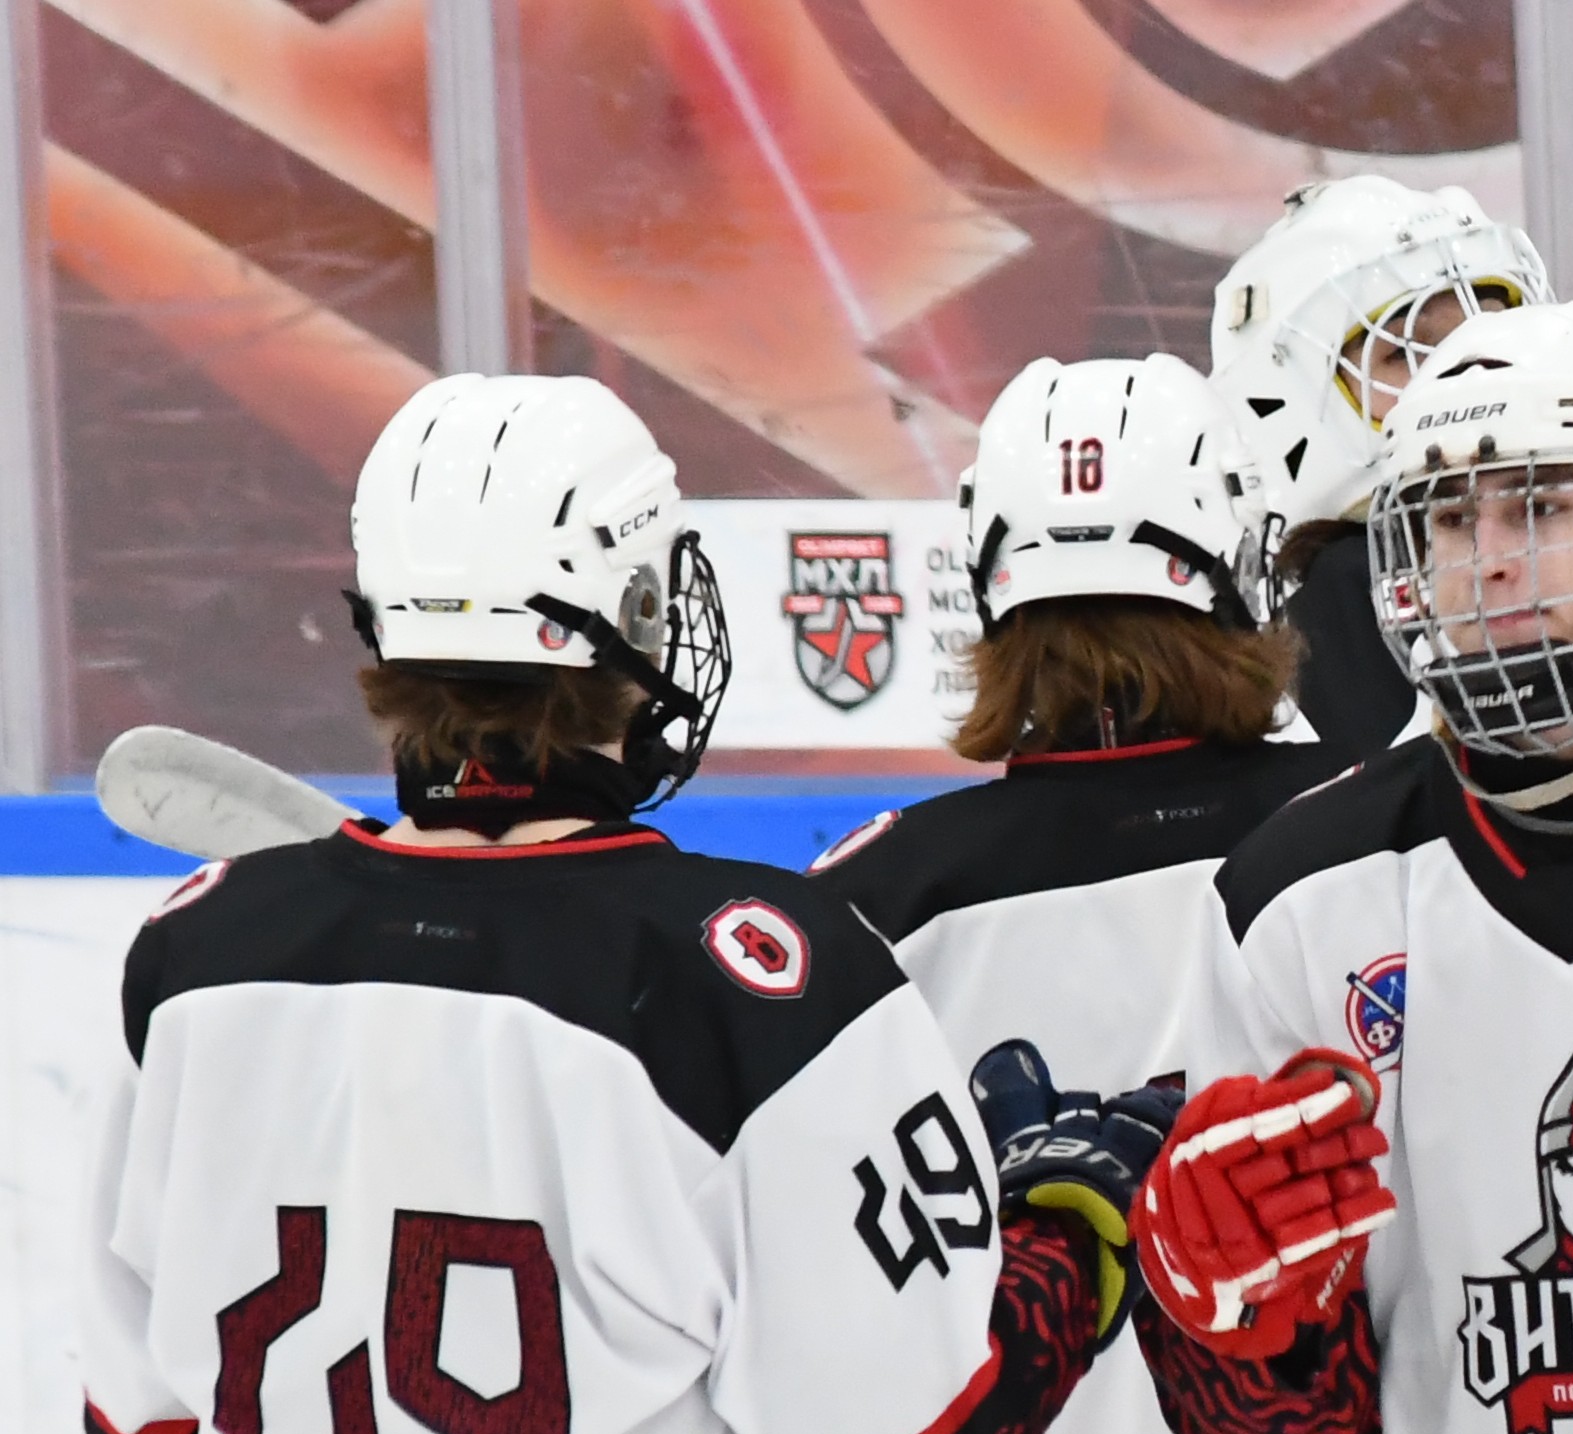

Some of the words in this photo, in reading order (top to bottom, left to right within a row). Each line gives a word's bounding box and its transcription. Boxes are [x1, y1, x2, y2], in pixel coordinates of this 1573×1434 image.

[1416, 402, 1507, 431] BAUER
[1059, 437, 1103, 496] 18
[619, 504, 658, 538] CCM
[794, 559, 889, 595] МХЛ
[853, 1091, 991, 1292] 49
